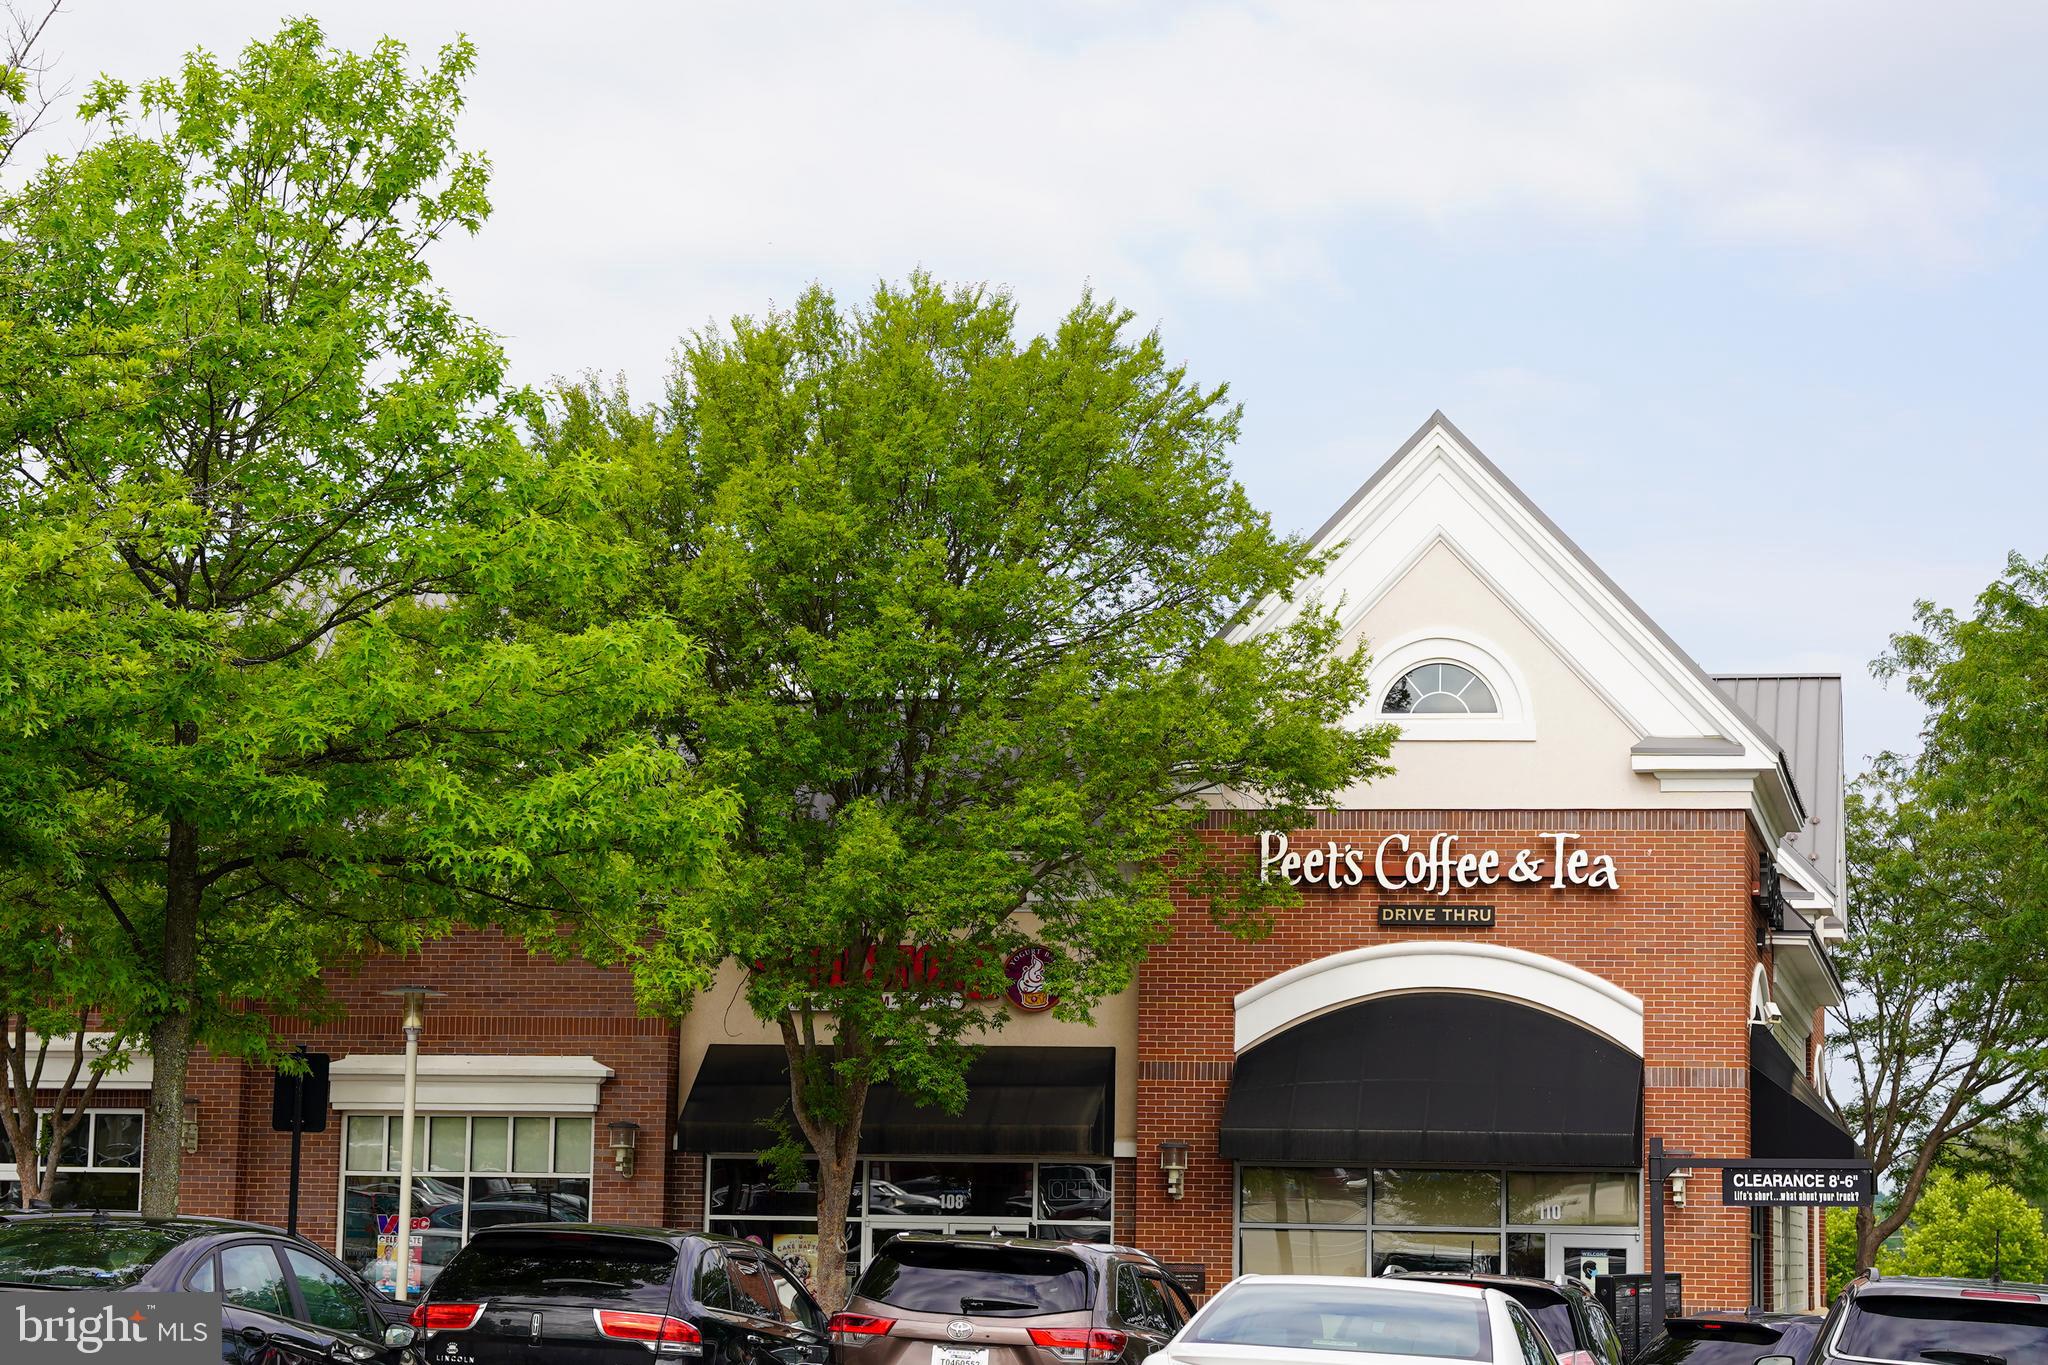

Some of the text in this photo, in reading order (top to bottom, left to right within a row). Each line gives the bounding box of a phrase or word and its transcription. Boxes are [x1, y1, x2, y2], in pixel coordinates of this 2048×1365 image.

[1260, 830, 1620, 896] Peet's Coffee & Tea
[1382, 909, 1492, 922] DRIVE THRU
[1009, 948, 1042, 966] YOGURT
[1733, 1173, 1825, 1188] CLEARANCE
[1051, 1181, 1104, 1199] OPEN
[1734, 1190, 1753, 1201] Life's
[1798, 1191, 1818, 1202] about
[1818, 1192, 1835, 1203] your
[1836, 1191, 1859, 1202] truck?
[939, 1194, 964, 1209] 108
[1540, 1204, 1561, 1220] 110
[777, 1244, 795, 1252] CAKE
[436, 1354, 475, 1364] LINCOLN
